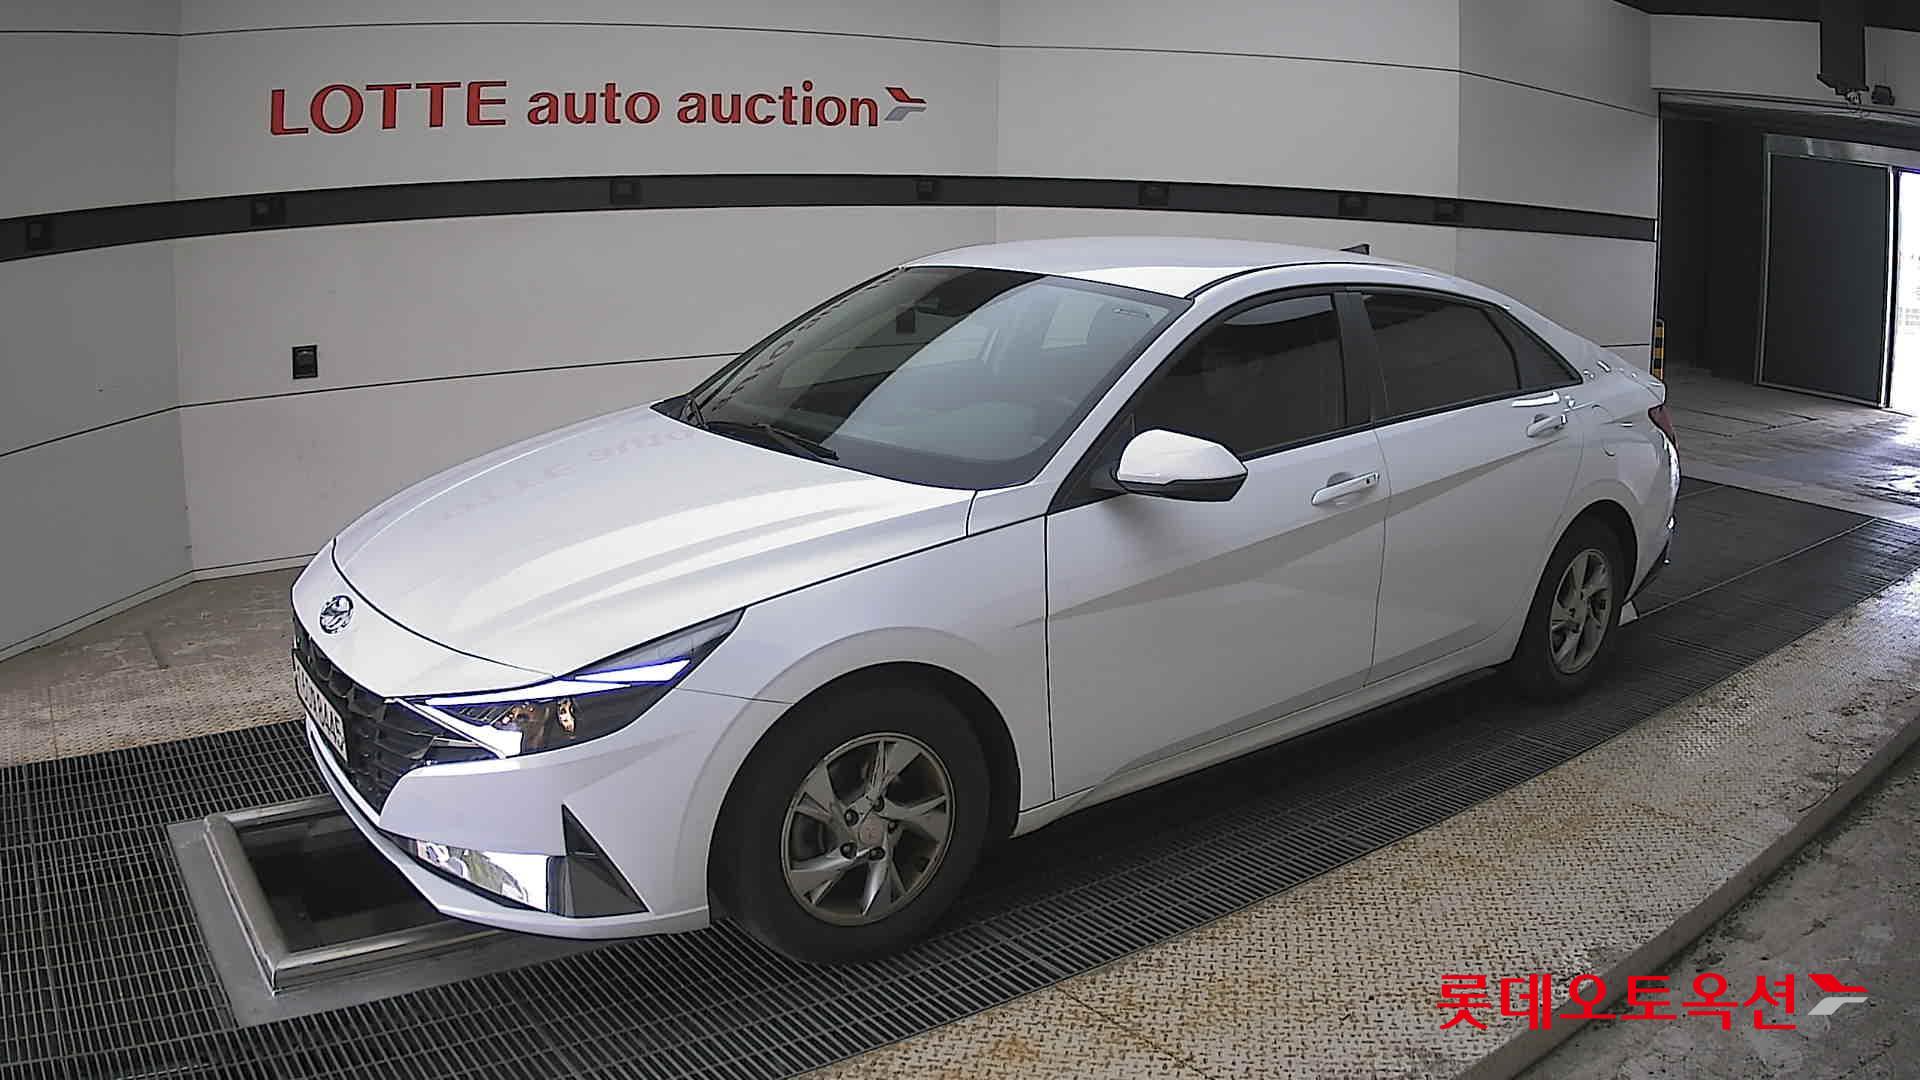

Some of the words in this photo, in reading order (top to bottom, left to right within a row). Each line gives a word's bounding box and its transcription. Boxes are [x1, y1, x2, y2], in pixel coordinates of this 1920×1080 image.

[270, 80, 507, 136] LOTTE
[527, 82, 661, 126] auto
[677, 81, 879, 127] auction
